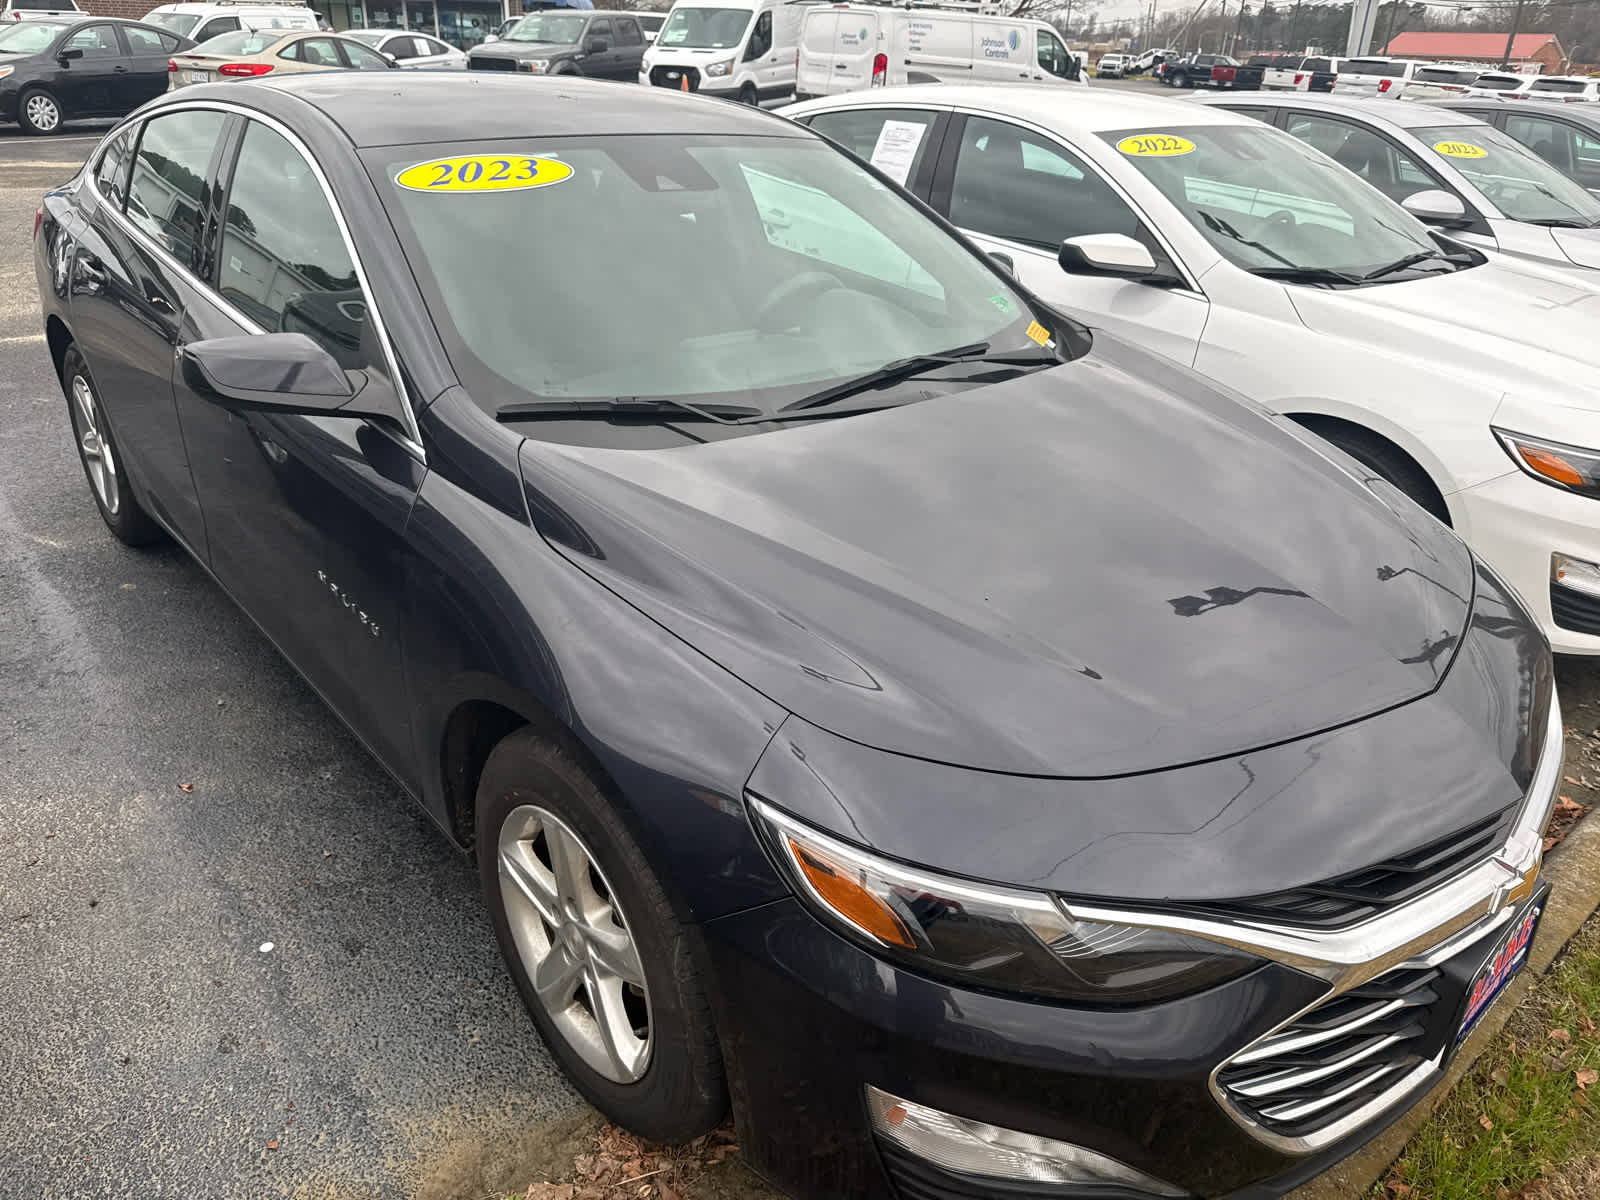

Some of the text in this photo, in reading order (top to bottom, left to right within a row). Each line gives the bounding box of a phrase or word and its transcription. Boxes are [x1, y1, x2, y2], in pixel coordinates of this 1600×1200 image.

[982, 37, 1005, 48] Johnson
[984, 47, 1009, 59] Controls
[1132, 137, 1182, 153] 2022
[1442, 143, 1479, 155] 2023
[428, 159, 539, 187] 2023
